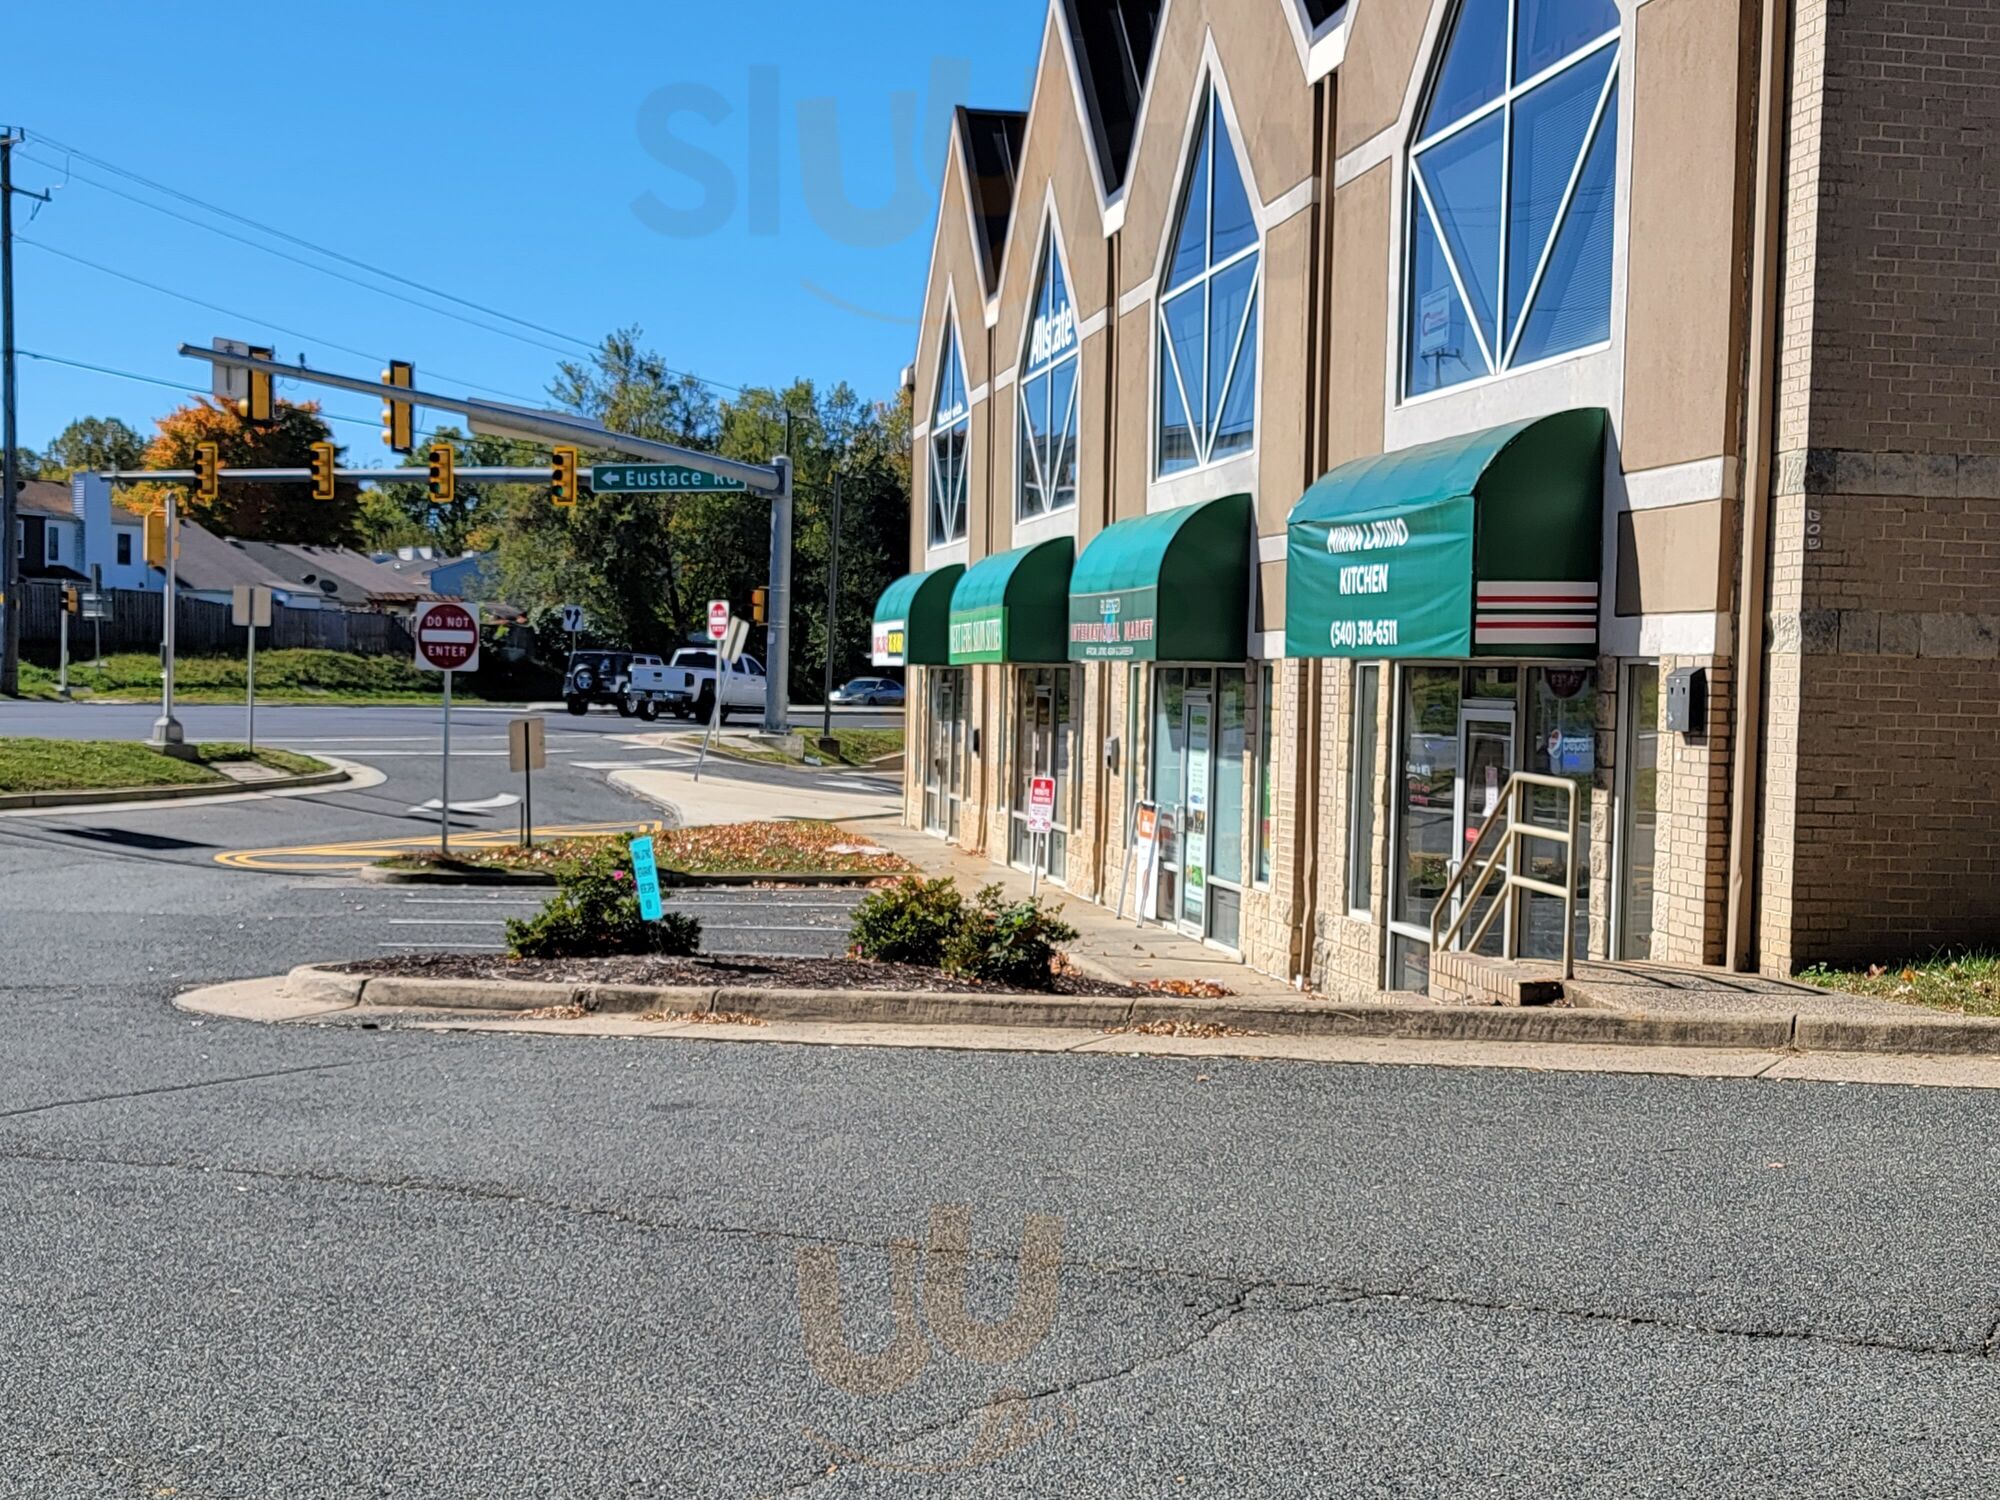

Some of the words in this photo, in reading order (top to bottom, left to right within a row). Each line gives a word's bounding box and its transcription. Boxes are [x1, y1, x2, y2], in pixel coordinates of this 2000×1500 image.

[1029, 300, 1072, 368] Allstate
[625, 470, 702, 486] Eustace
[1327, 525, 1363, 554] MIRNA
[1363, 518, 1409, 550] LATINO
[1340, 564, 1388, 595] KITCHEN
[427, 615, 442, 627] DO
[447, 616, 470, 628] NOT
[1124, 619, 1153, 642] MARKET
[1330, 620, 1356, 648] (540)
[1357, 620, 1398, 646] 318-6511
[428, 645, 467, 657] ENTER
